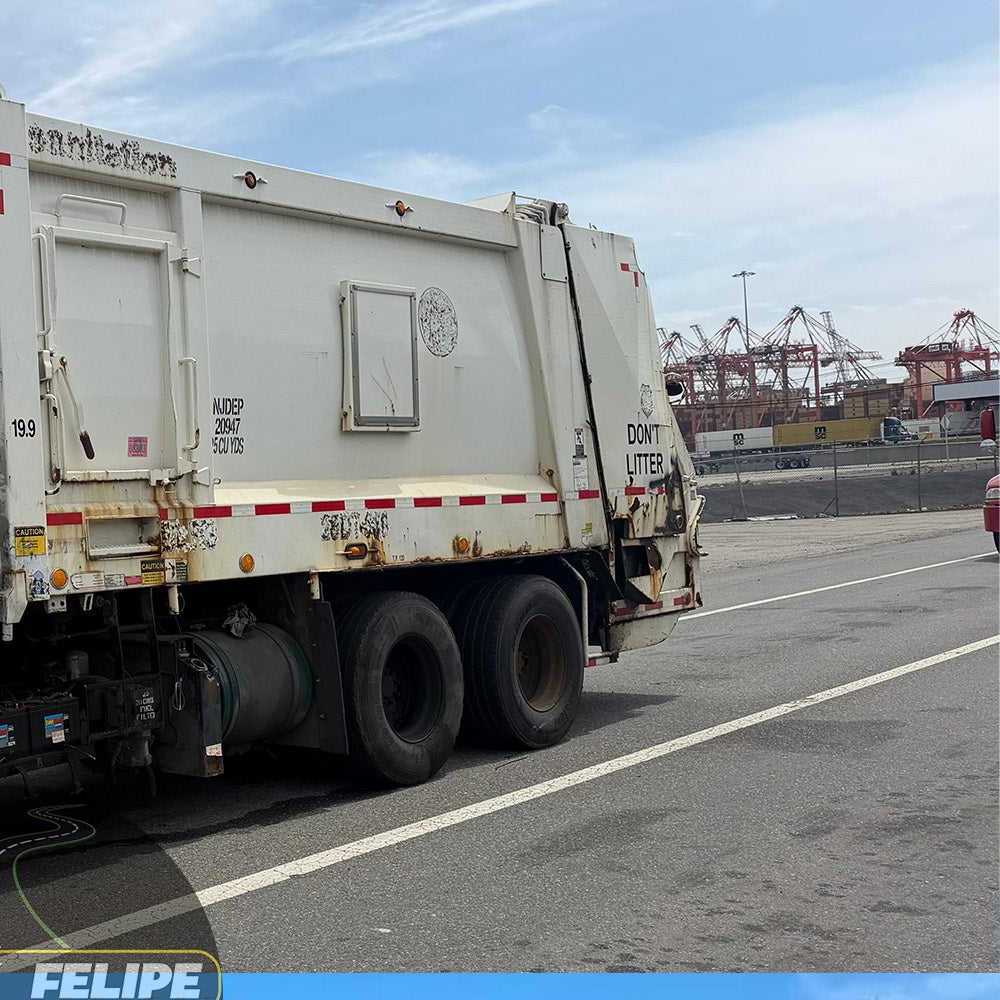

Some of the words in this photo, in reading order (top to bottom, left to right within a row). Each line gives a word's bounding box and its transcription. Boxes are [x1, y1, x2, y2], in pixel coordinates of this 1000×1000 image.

[212, 397, 244, 415] NJDEP
[11, 418, 36, 438] 19.9
[214, 418, 241, 435] 20947
[627, 423, 660, 445] DON'T
[218, 436, 230, 454] CU
[230, 436, 244, 454] YDS
[625, 452, 664, 475] LITTER
[15, 528, 44, 537] CAUTION
